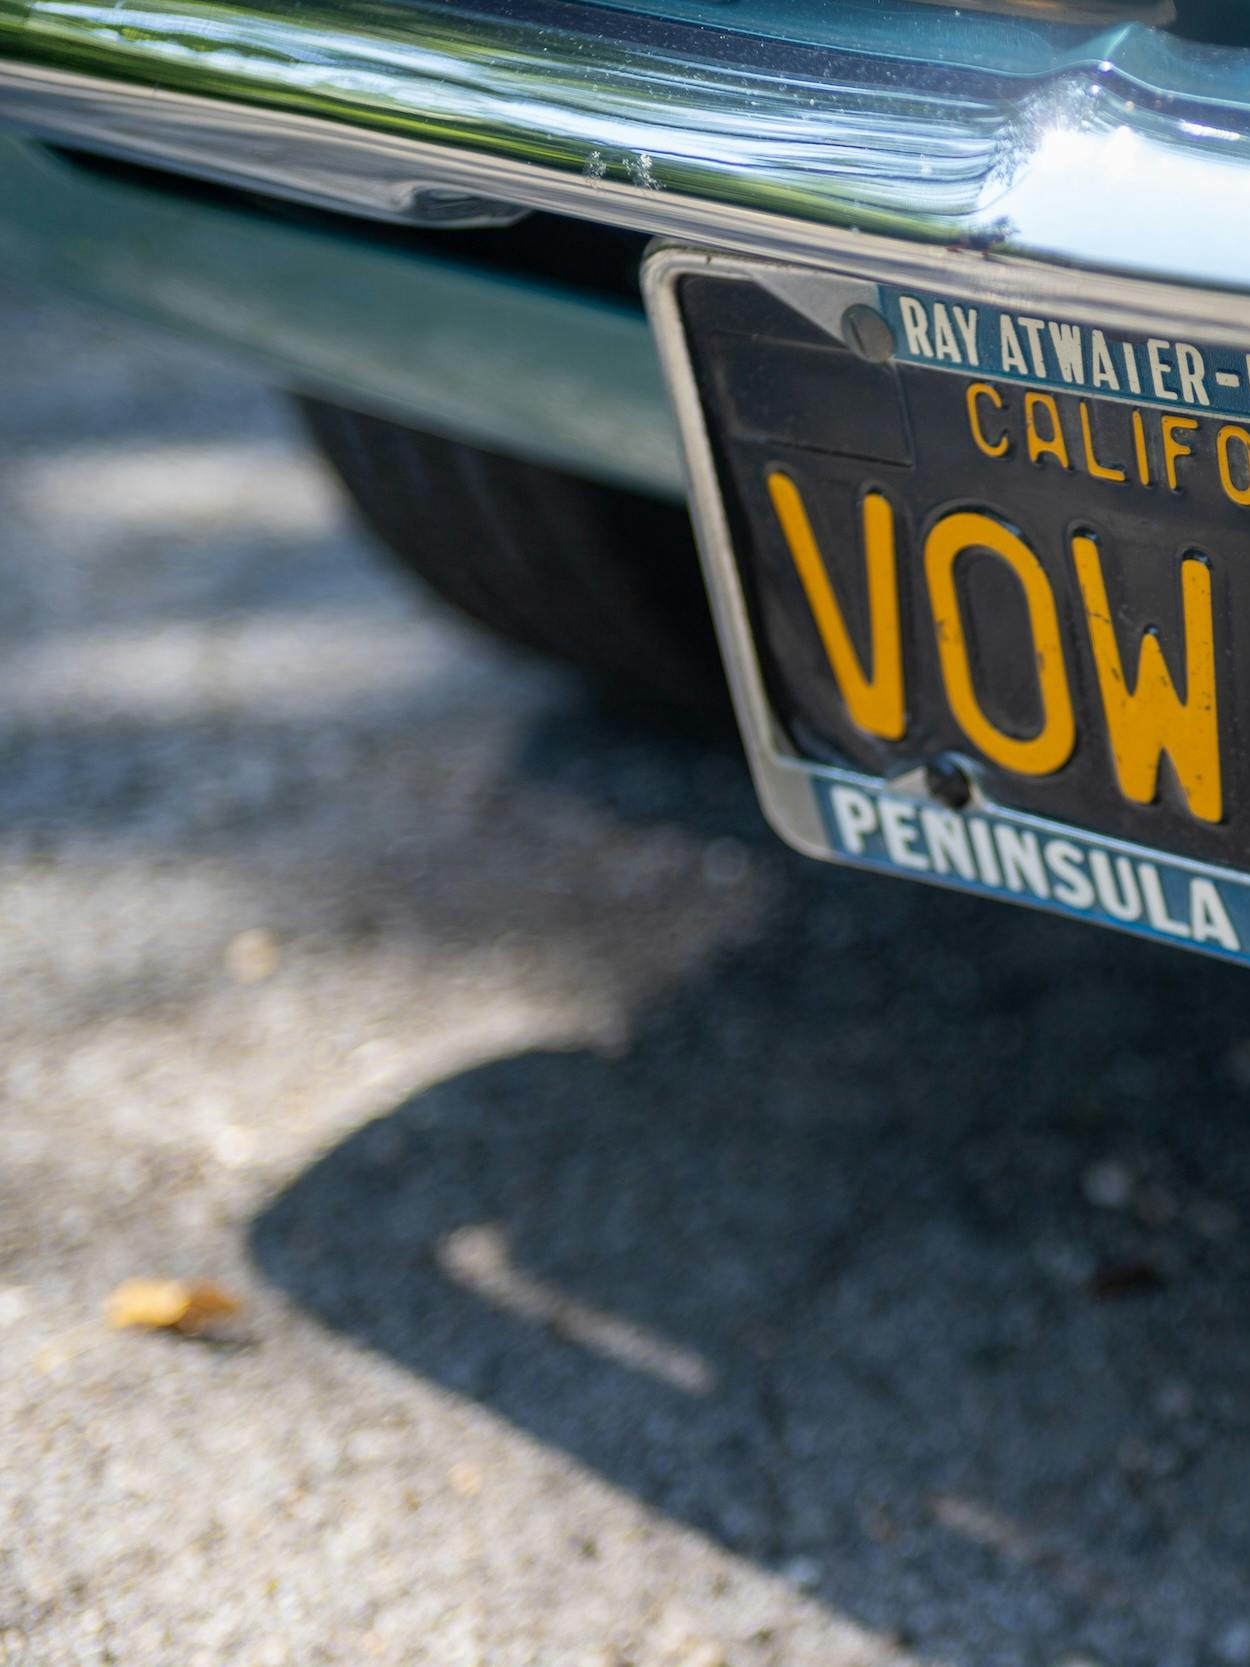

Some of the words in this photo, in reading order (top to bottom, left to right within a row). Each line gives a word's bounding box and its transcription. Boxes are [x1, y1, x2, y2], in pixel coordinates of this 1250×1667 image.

[899, 297, 979, 367] RAY
[768, 472, 1223, 824] VOW
[829, 785, 1240, 952] PENINSULA
